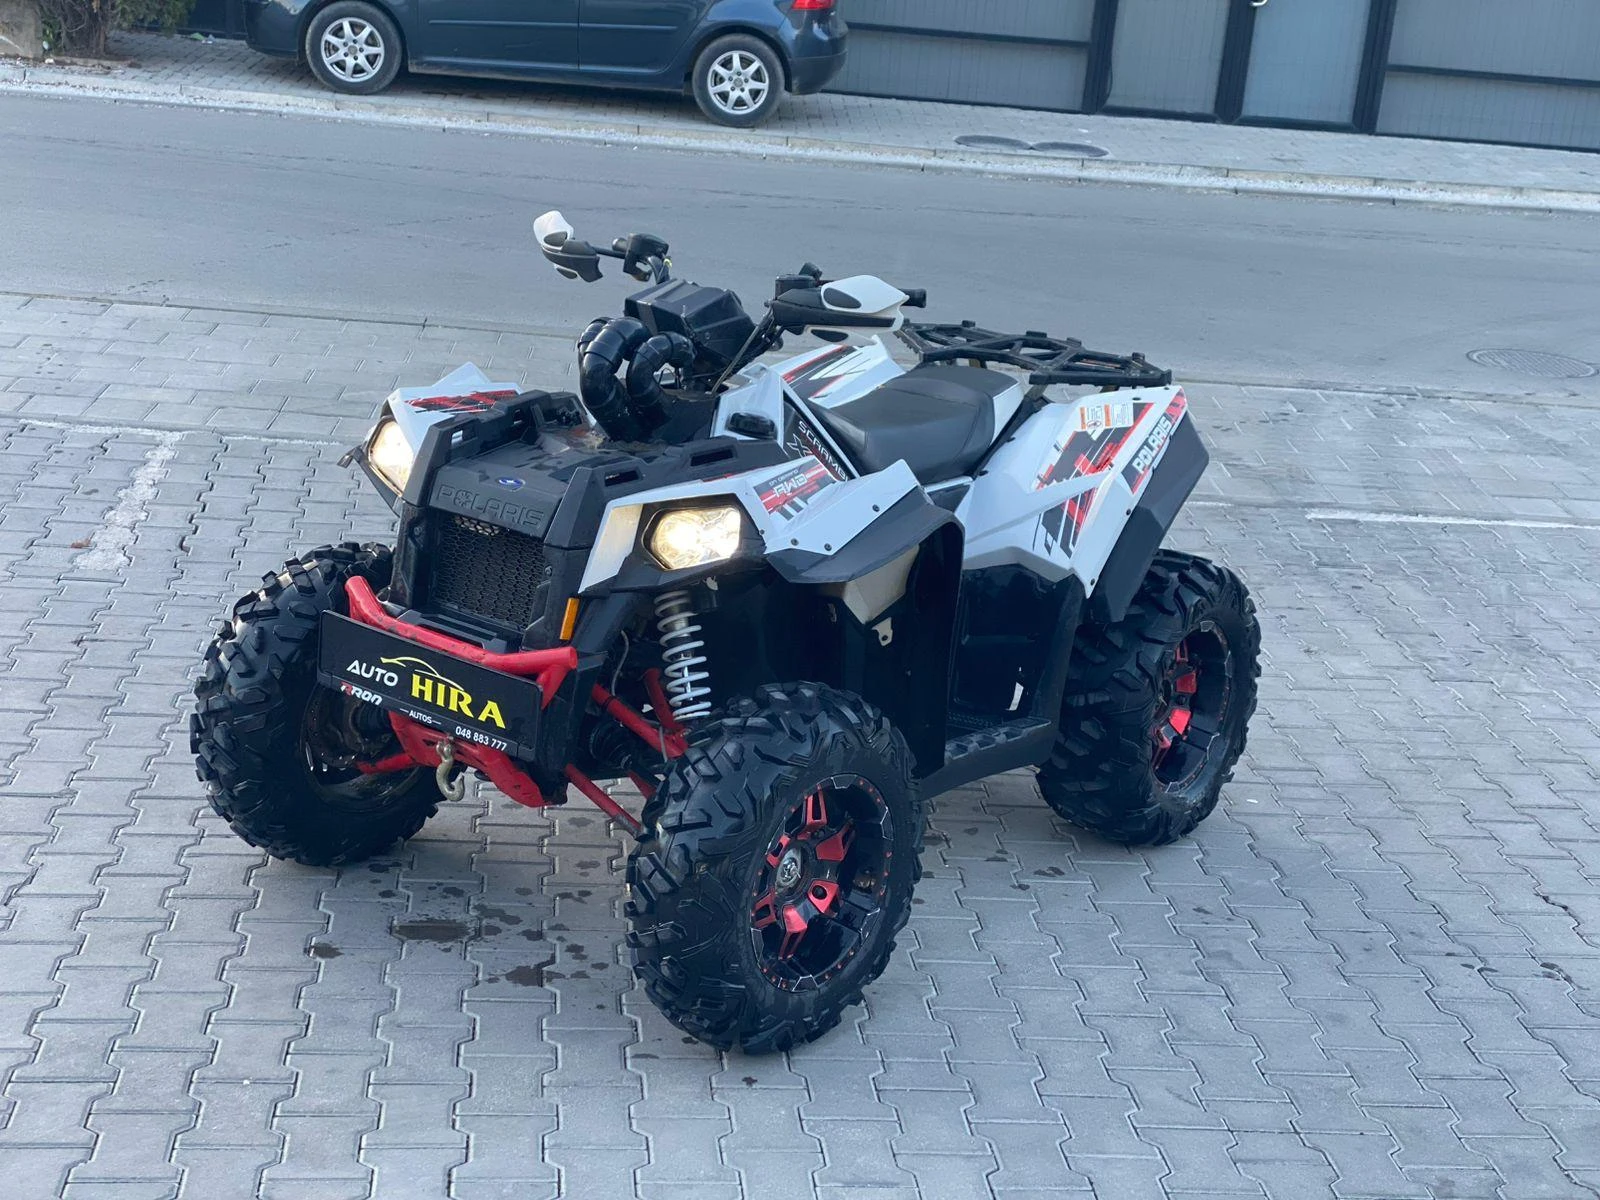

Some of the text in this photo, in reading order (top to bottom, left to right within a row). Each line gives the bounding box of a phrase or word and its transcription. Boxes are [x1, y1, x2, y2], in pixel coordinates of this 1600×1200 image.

[1132, 416, 1172, 474] POLARIS
[436, 484, 544, 526] POLARIS
[346, 659, 506, 730] AUTO HIRA
[408, 709, 433, 725] AUTOS
[455, 725, 508, 751] 048 883 777
